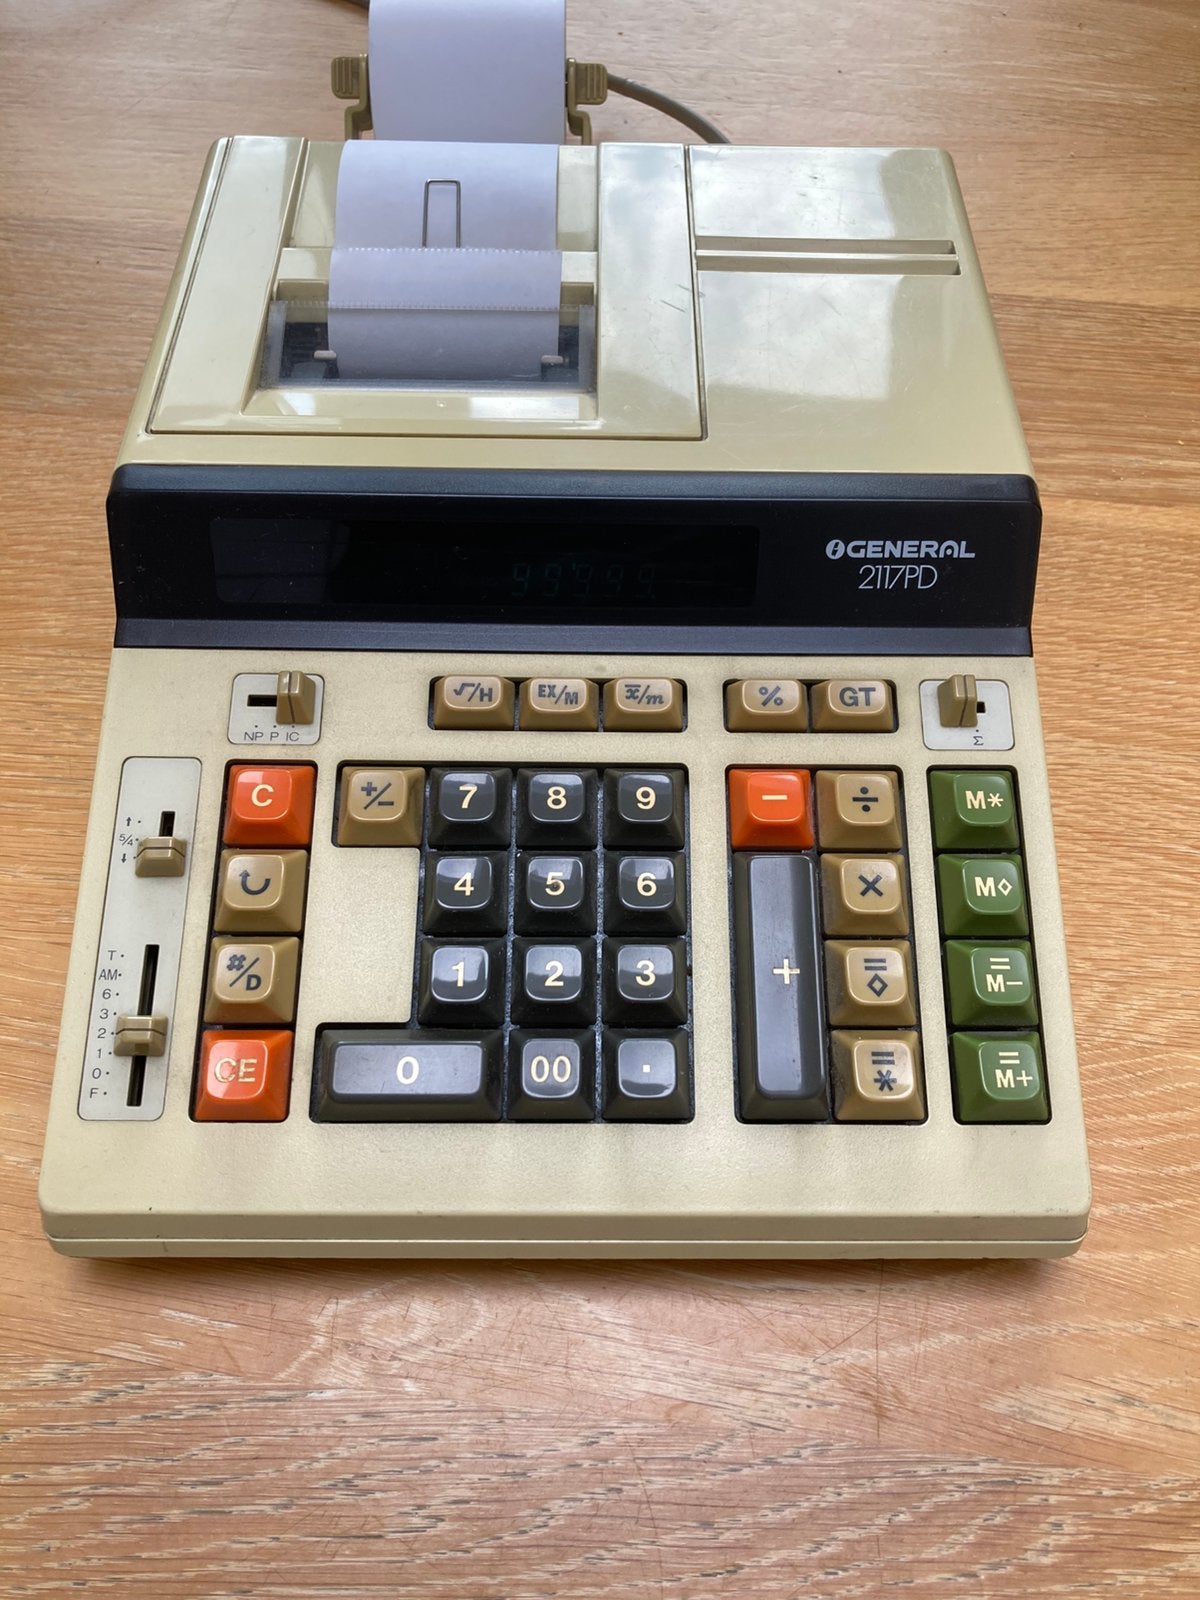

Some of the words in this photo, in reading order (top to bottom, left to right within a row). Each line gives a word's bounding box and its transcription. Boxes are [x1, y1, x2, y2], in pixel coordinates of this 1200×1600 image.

[846, 540, 975, 559] GENERAL
[858, 565, 938, 589] 2117PD
[538, 684, 578, 706] EX/M
[759, 686, 783, 707] %
[839, 687, 876, 707] GT
[244, 732, 263, 741] NP
[270, 732, 279, 741] P
[286, 732, 300, 742] IC
[251, 784, 274, 807] C
[459, 785, 478, 809] 7
[546, 786, 567, 809] 8
[635, 786, 656, 810] 9
[119, 834, 133, 846] 5/4
[454, 872, 474, 896] 4
[545, 872, 565, 896] 5
[636, 872, 657, 896] 6
[108, 950, 116, 961] T
[99, 969, 117, 980] AM
[451, 961, 465, 987] 1
[544, 960, 564, 987] 2
[635, 960, 656, 986] 3
[102, 989, 111, 999] 6
[100, 1009, 109, 1019] 3
[97, 1028, 106, 1038] 2
[97, 1048, 102, 1058] 1
[214, 1057, 257, 1083] CE
[396, 1056, 419, 1085] 0
[530, 1055, 571, 1083] 00
[995, 1069, 1033, 1089] M+
[89, 1088, 98, 1098] F
